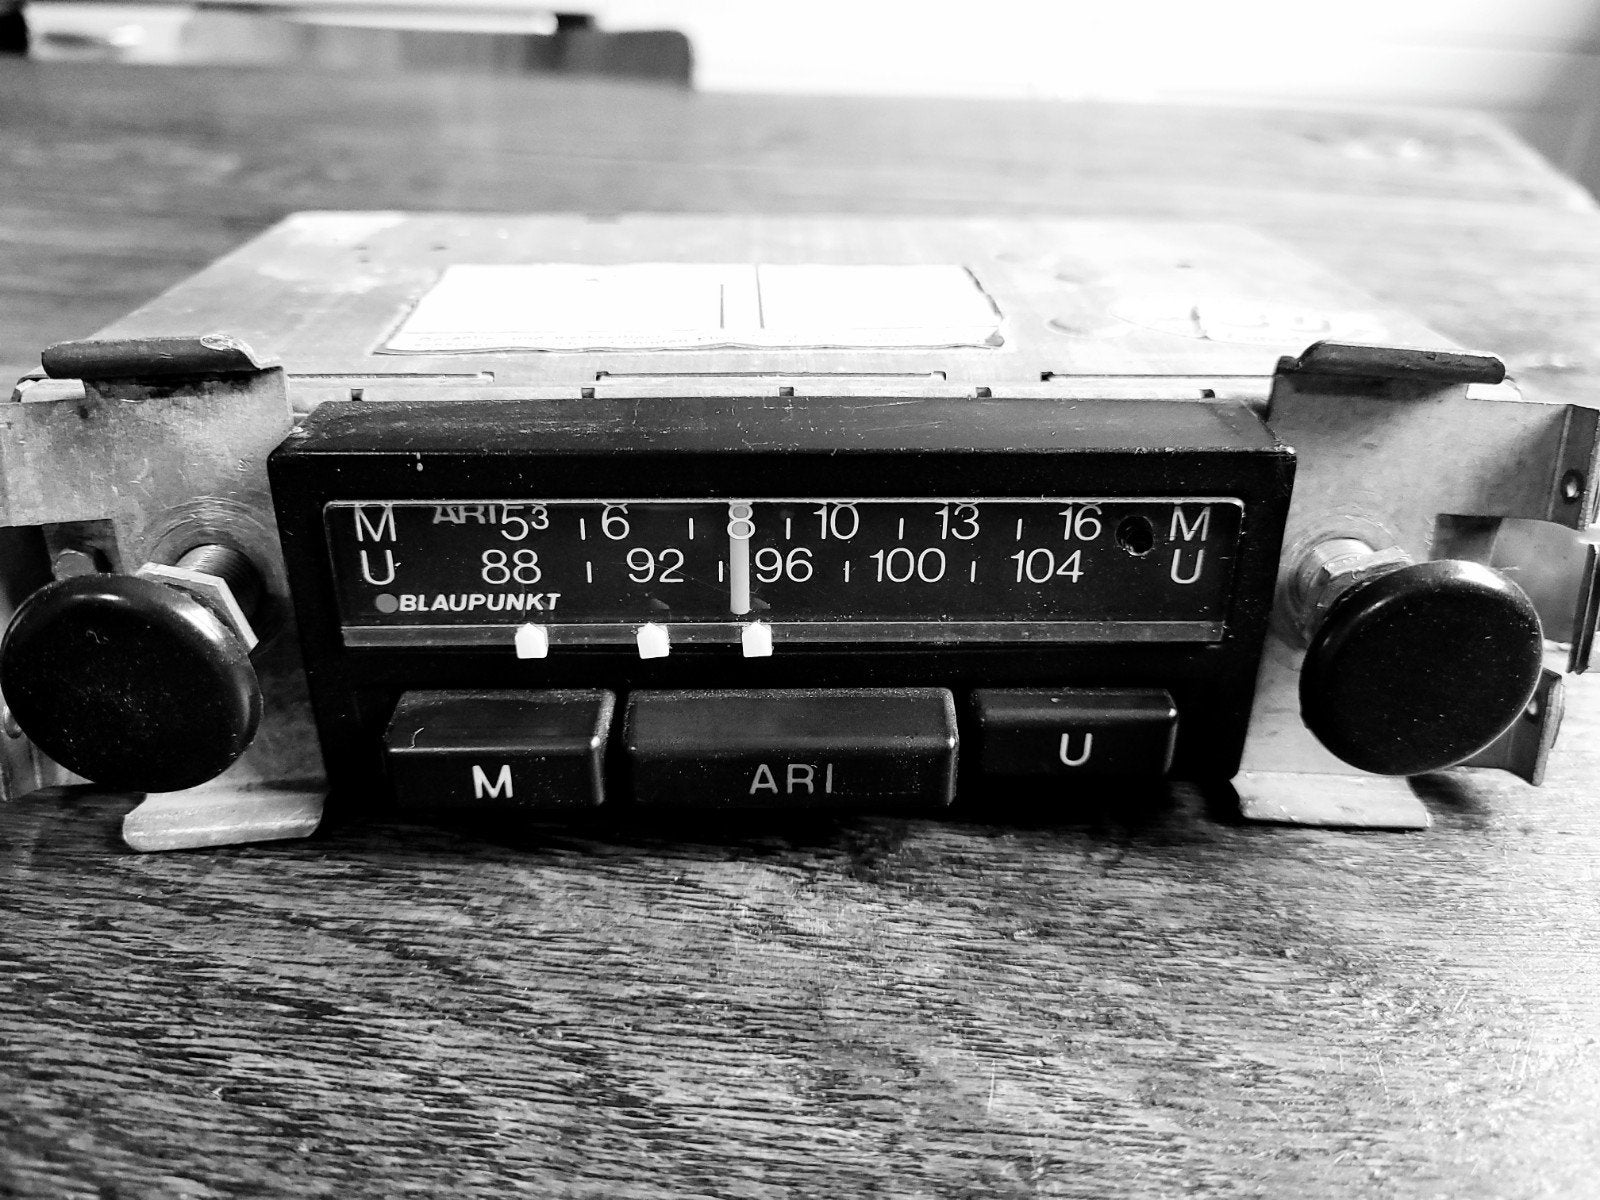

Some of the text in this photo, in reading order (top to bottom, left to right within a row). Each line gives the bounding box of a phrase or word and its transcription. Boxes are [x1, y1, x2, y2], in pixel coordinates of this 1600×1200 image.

[354, 500, 397, 542] M
[600, 503, 630, 540] 6
[726, 501, 755, 540] 8
[812, 501, 859, 540] 10
[935, 501, 980, 540] 13
[1058, 501, 1102, 541] 16
[1169, 503, 1211, 542] M
[359, 549, 396, 585] U
[481, 547, 1085, 584] 88 92 96 100 104
[1169, 548, 1206, 584] U
[399, 592, 562, 612] BLAUPUNKT
[1059, 732, 1093, 768] U
[472, 764, 514, 799] M
[749, 763, 834, 795] ARI
